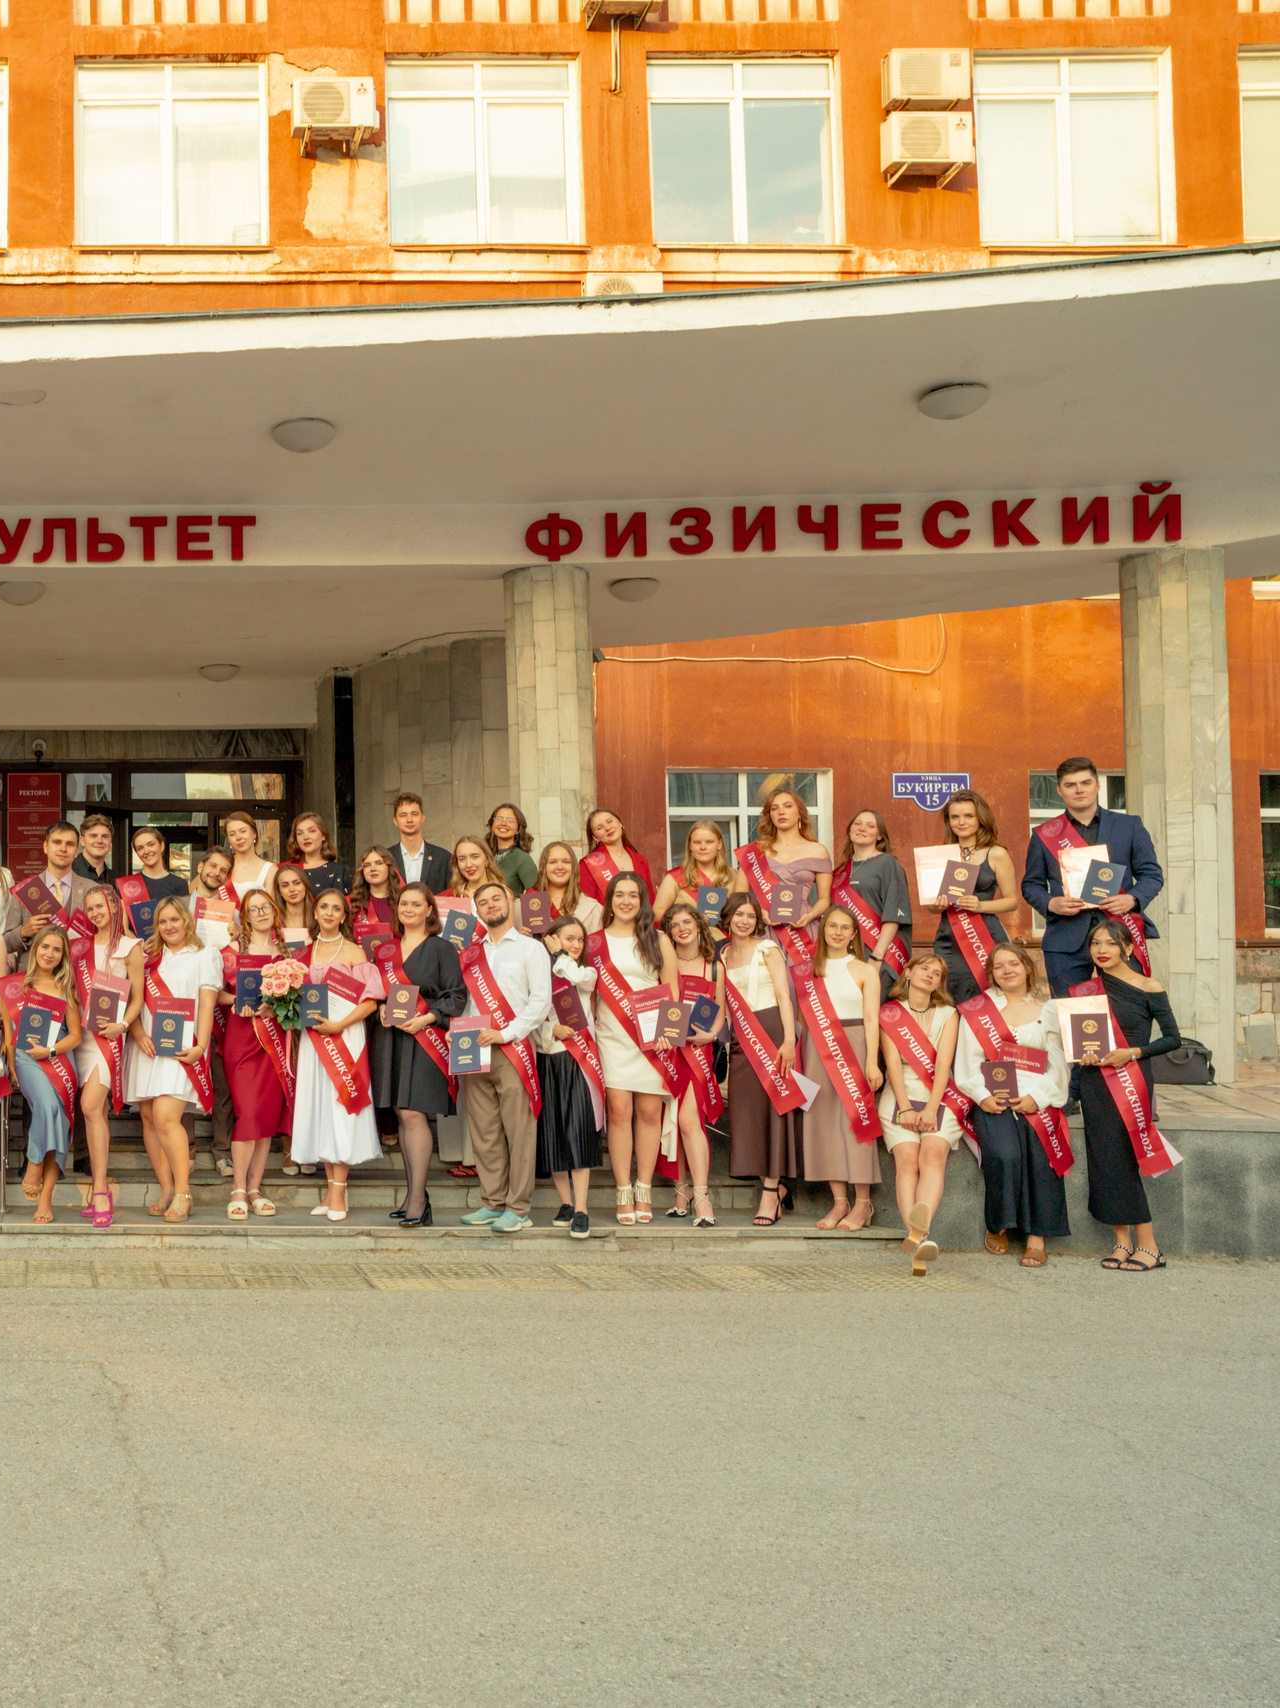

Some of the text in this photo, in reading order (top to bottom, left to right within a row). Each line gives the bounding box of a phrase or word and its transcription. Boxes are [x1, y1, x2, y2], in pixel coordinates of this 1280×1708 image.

[524, 481, 1182, 562] ФИЗИЧЕСКИЙ
[897, 783, 966, 793] БУКИРЕВА
[926, 794, 940, 806] 15
[747, 851, 770, 893] ЛУЧШИЙ
[839, 889, 873, 930] ЛУЧШИЙ
[471, 965, 498, 1015] ЛУЧШИЙ
[593, 955, 625, 1001] ЛУЧШИЙ
[736, 1010, 790, 1098] ВЫПУСКНИК 2024
[804, 980, 870, 1126] ЛУЧШИЙ ВЫПУСКНИК 2024
[898, 1026, 935, 1074] ЛУЧШИЙ
[198, 1072, 210, 1096] 2024
[342, 1073, 358, 1098] 2024
[663, 1059, 678, 1082] 2024
[708, 1080, 716, 1105] 2024
[1049, 1134, 1063, 1158] 2024
[1140, 1131, 1155, 1158] 2024
